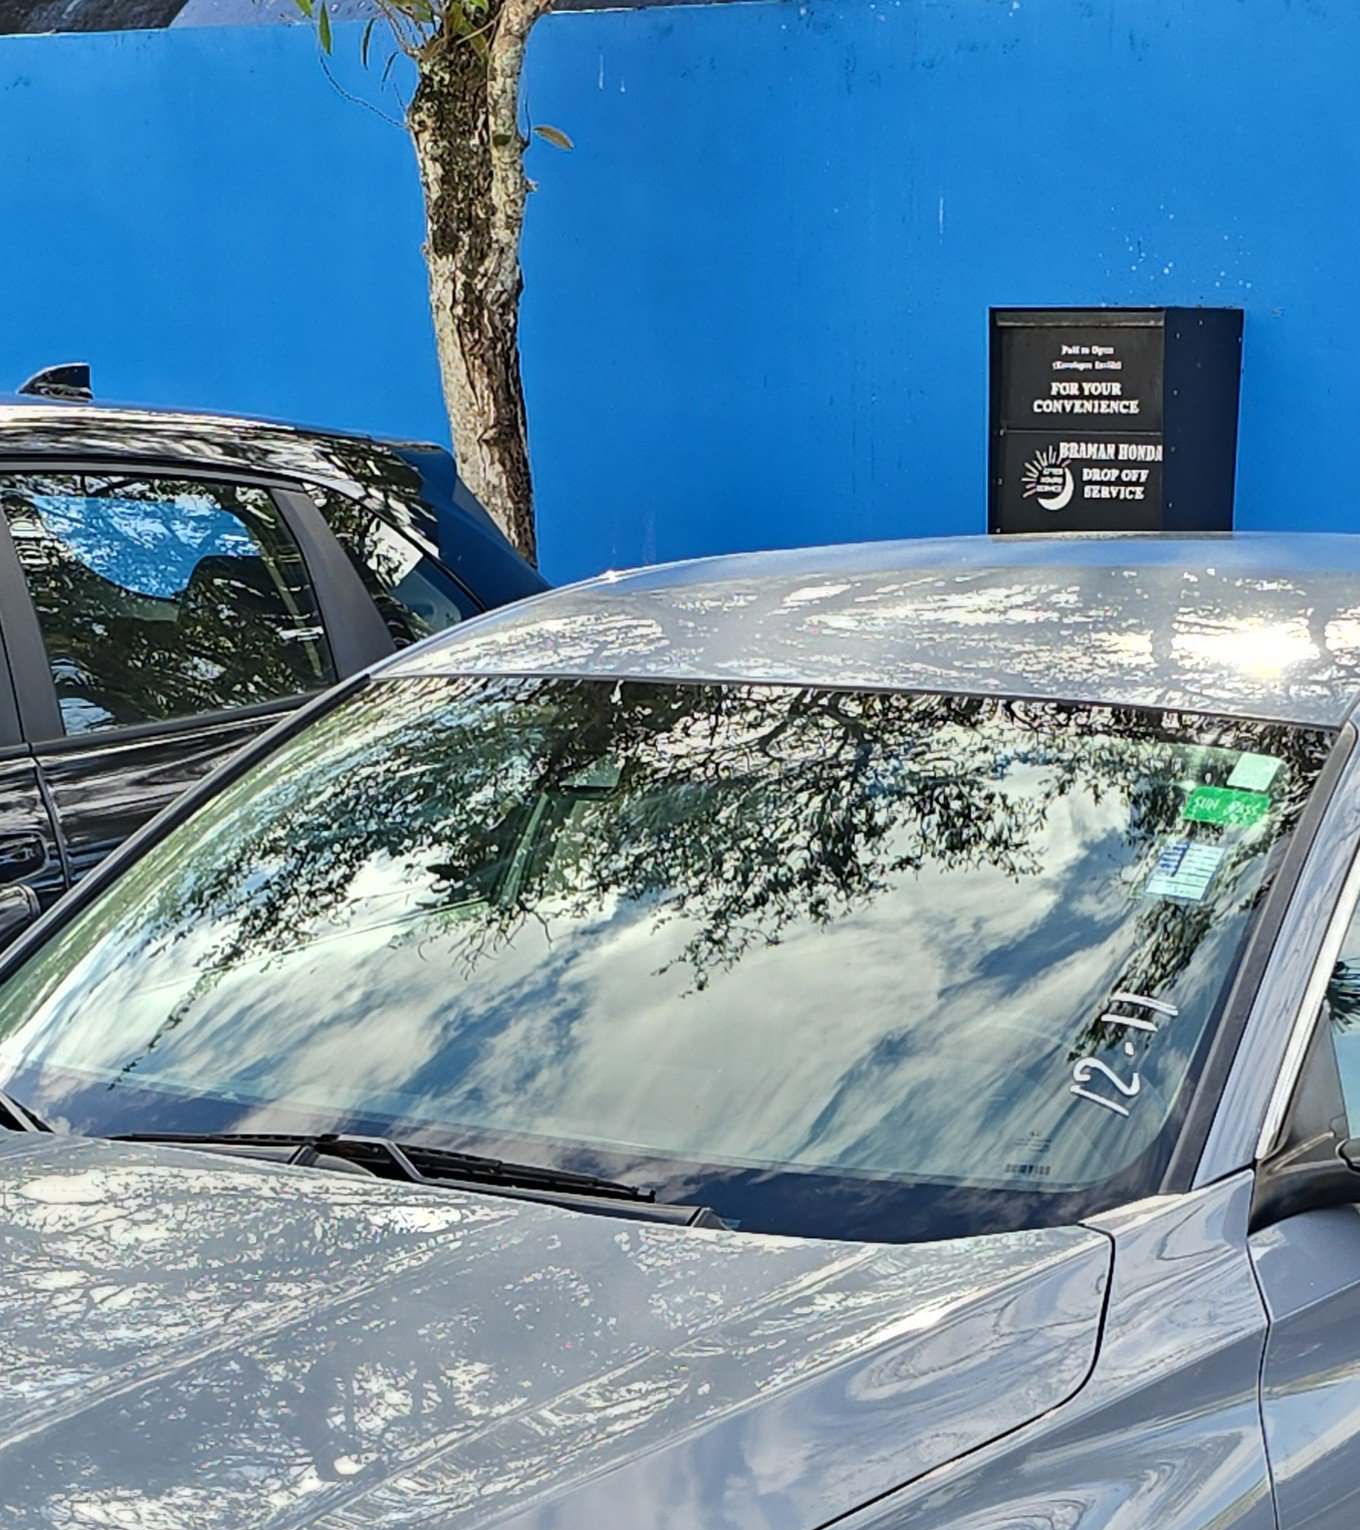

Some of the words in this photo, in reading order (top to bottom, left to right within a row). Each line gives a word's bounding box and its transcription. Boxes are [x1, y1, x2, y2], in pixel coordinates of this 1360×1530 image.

[1051, 382, 1080, 396] FOR
[1082, 382, 1122, 396] YOUR
[1033, 399, 1140, 415] CONVENIENCE
[1059, 442, 1115, 461] BRAMAN
[1118, 444, 1164, 463] HONDA
[1082, 467, 1119, 482] DROP
[1121, 469, 1149, 483] OFF
[1083, 485, 1145, 500] SERVICE
